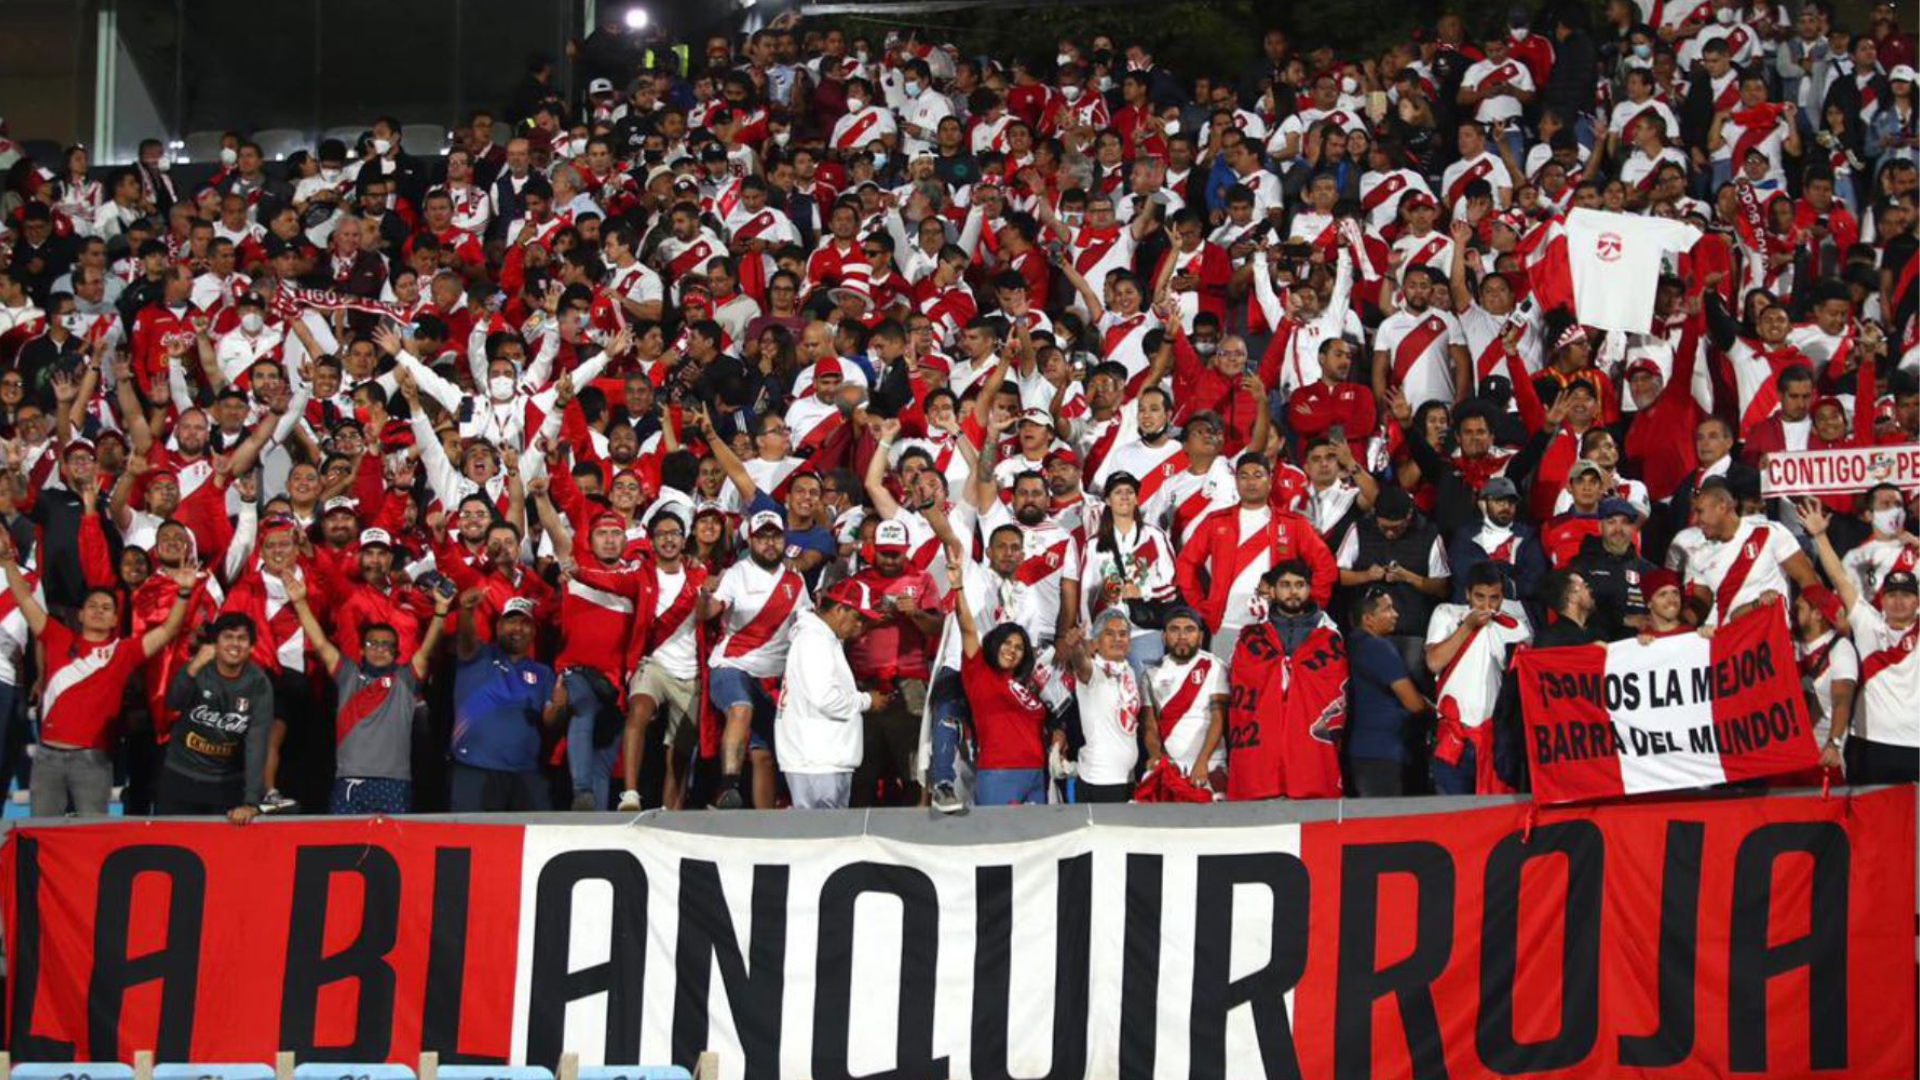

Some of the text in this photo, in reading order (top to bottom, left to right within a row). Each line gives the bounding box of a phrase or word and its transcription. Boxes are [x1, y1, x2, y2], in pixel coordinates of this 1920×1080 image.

[1769, 455, 1866, 485] CONTIGO
[1649, 669, 1684, 708] LA
[1692, 641, 1775, 704] MEJOR
[1534, 698, 1801, 765] BARRA DEL MUNDO!
[10, 820, 1851, 1080] LA BLANQUIRROJA
